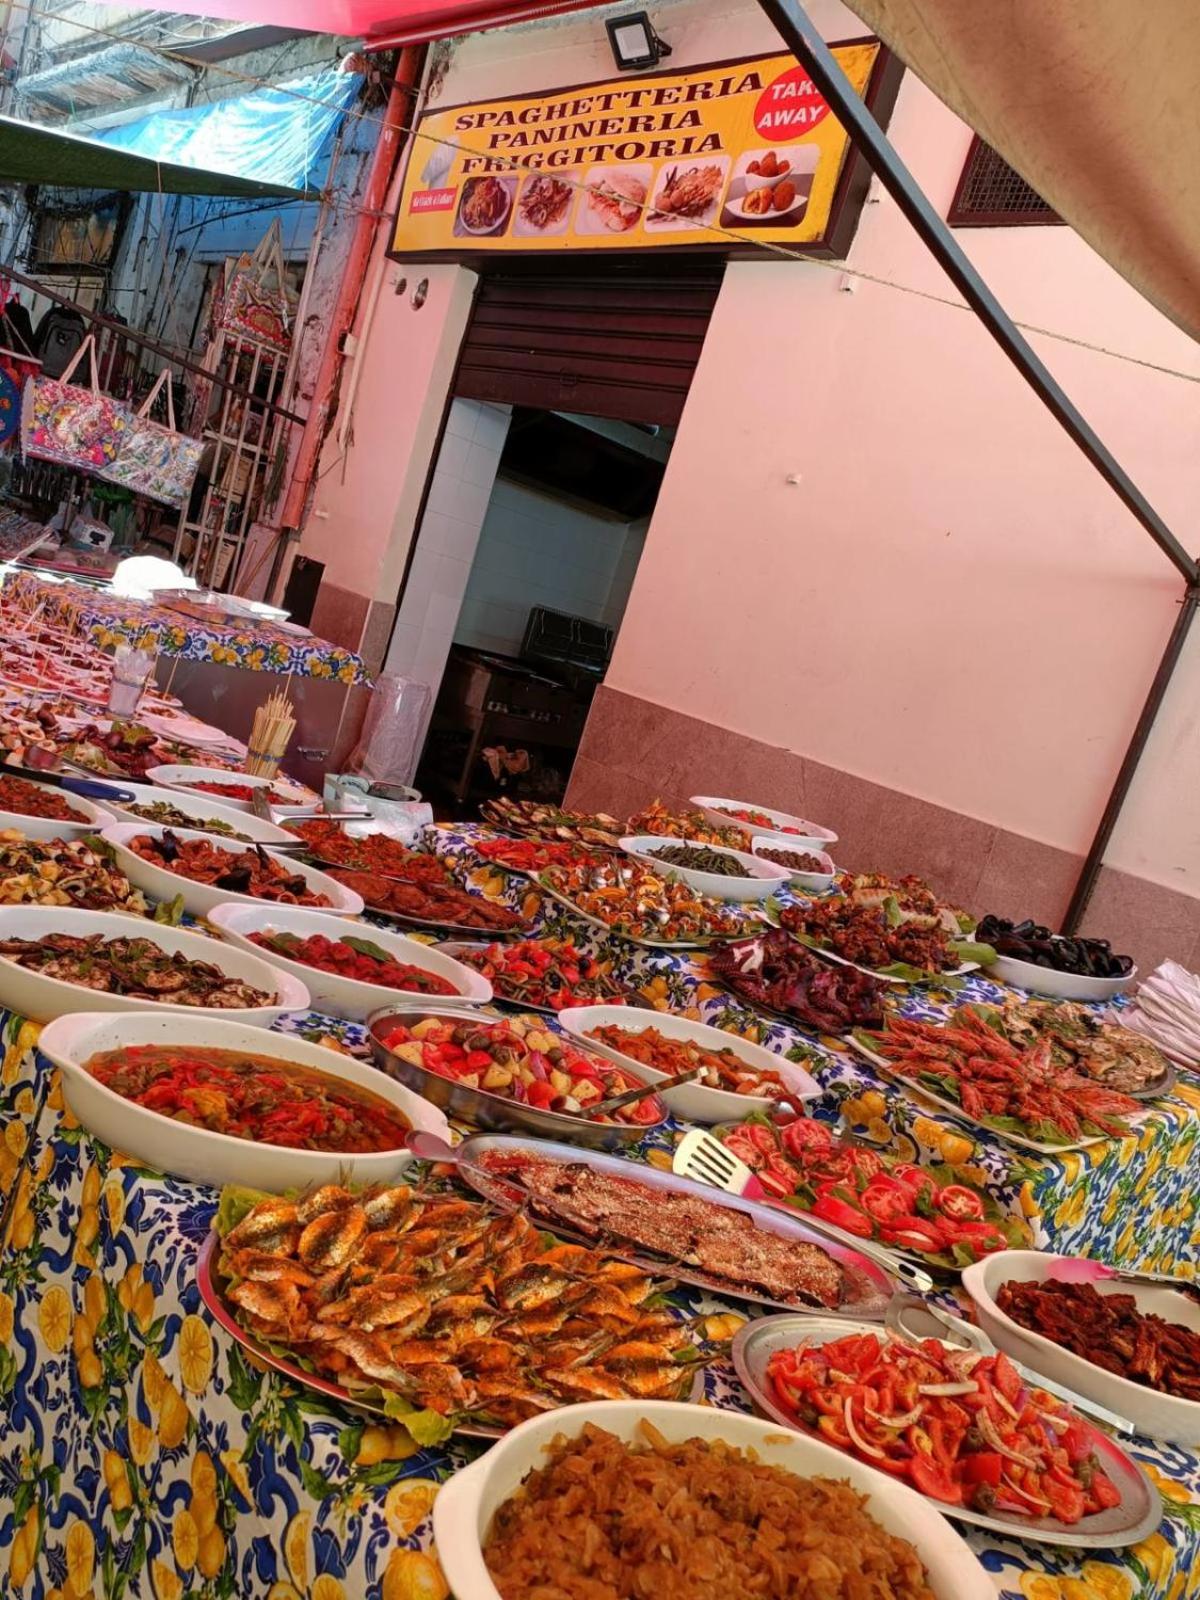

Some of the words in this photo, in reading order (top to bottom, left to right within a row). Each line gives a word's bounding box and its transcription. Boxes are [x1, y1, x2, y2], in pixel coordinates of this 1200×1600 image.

[455, 72, 764, 130] SPAGHETTERIA
[772, 80, 819, 99] TAK
[488, 109, 702, 149] PANINERIA
[757, 105, 825, 129] AWAY
[461, 133, 723, 173] FRIGGITORIA
